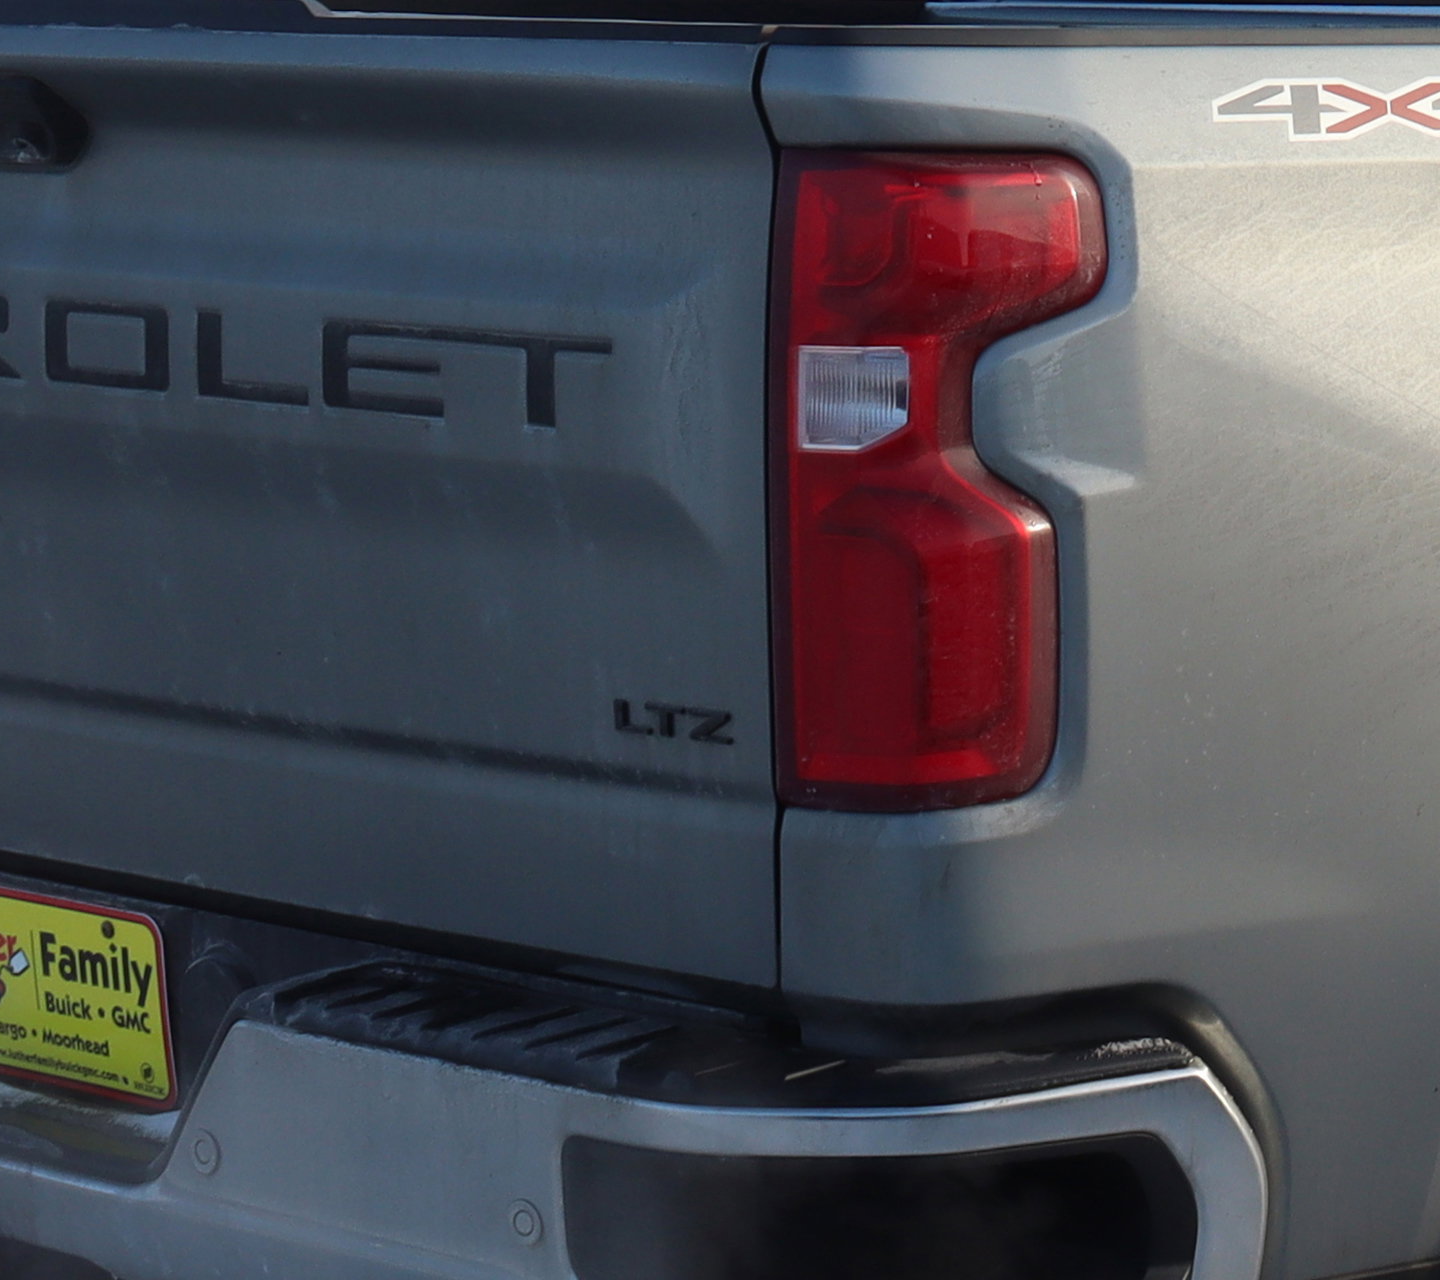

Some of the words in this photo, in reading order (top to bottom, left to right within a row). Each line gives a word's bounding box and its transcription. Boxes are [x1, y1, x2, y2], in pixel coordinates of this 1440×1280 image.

[613, 699, 735, 745] LTZ
[39, 931, 153, 1008] Family
[44, 991, 93, 1021] Buick
[111, 1006, 152, 1035] GMC
[41, 1027, 111, 1057] Moorhead
